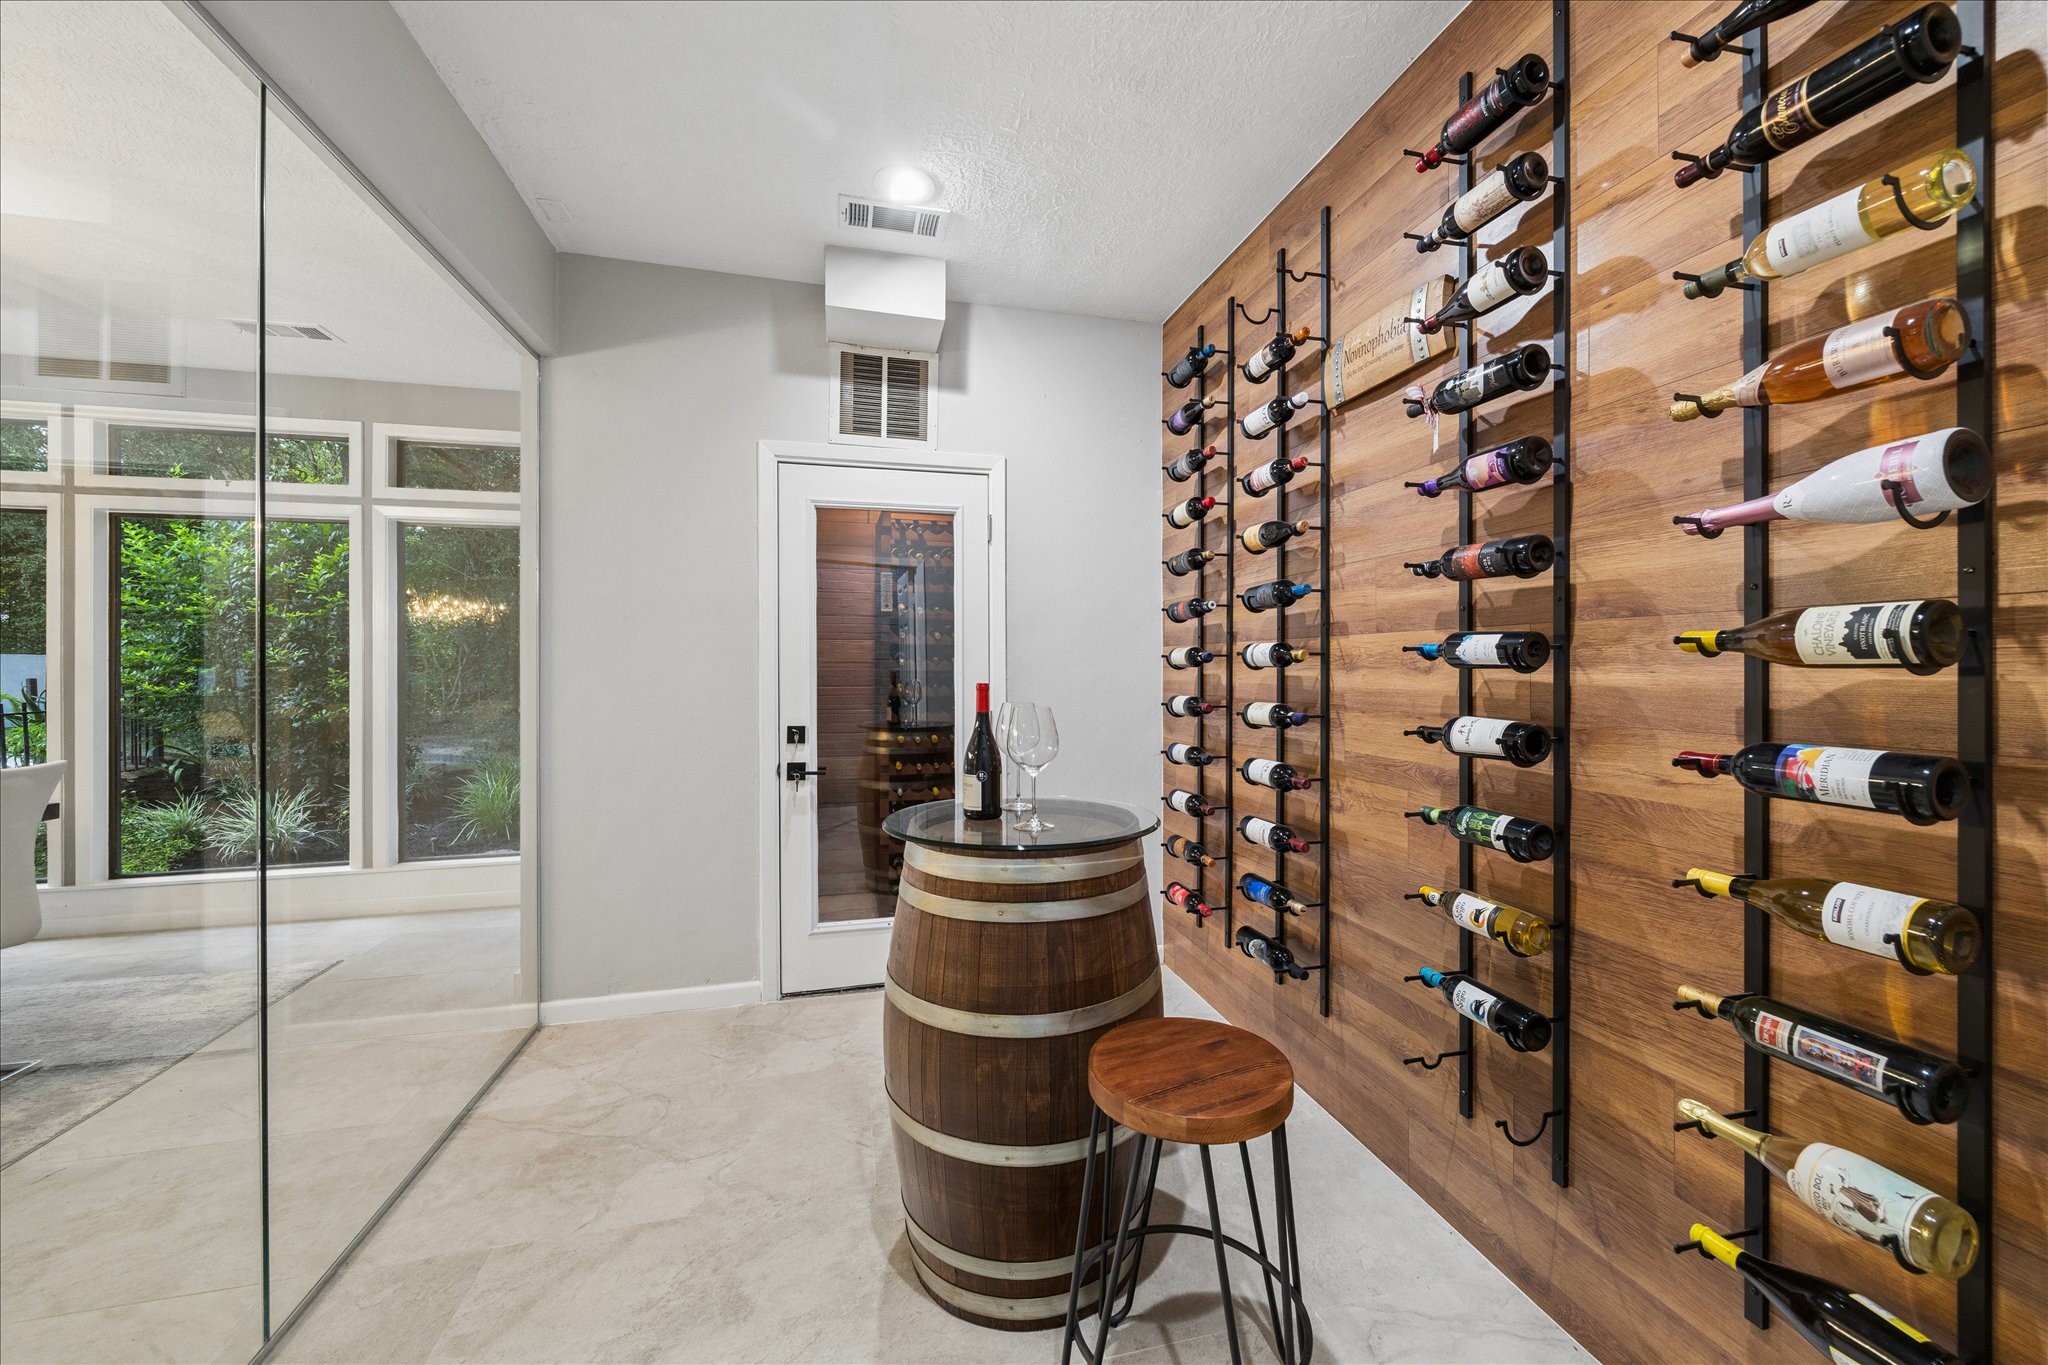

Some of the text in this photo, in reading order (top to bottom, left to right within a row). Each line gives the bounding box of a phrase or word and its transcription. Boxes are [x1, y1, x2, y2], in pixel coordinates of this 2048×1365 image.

[1772, 88, 1799, 138] Estancia
[1343, 316, 1407, 368] Novinophobia
[1812, 611, 1826, 656] CHALONE
[1824, 610, 1841, 656] VINEYARD
[1860, 613, 1870, 650] PINOT BLANC
[1819, 753, 1836, 798] MERIDIAN
[1850, 890, 1865, 914] COUNTY
[1813, 1172, 1824, 1190] DOC
